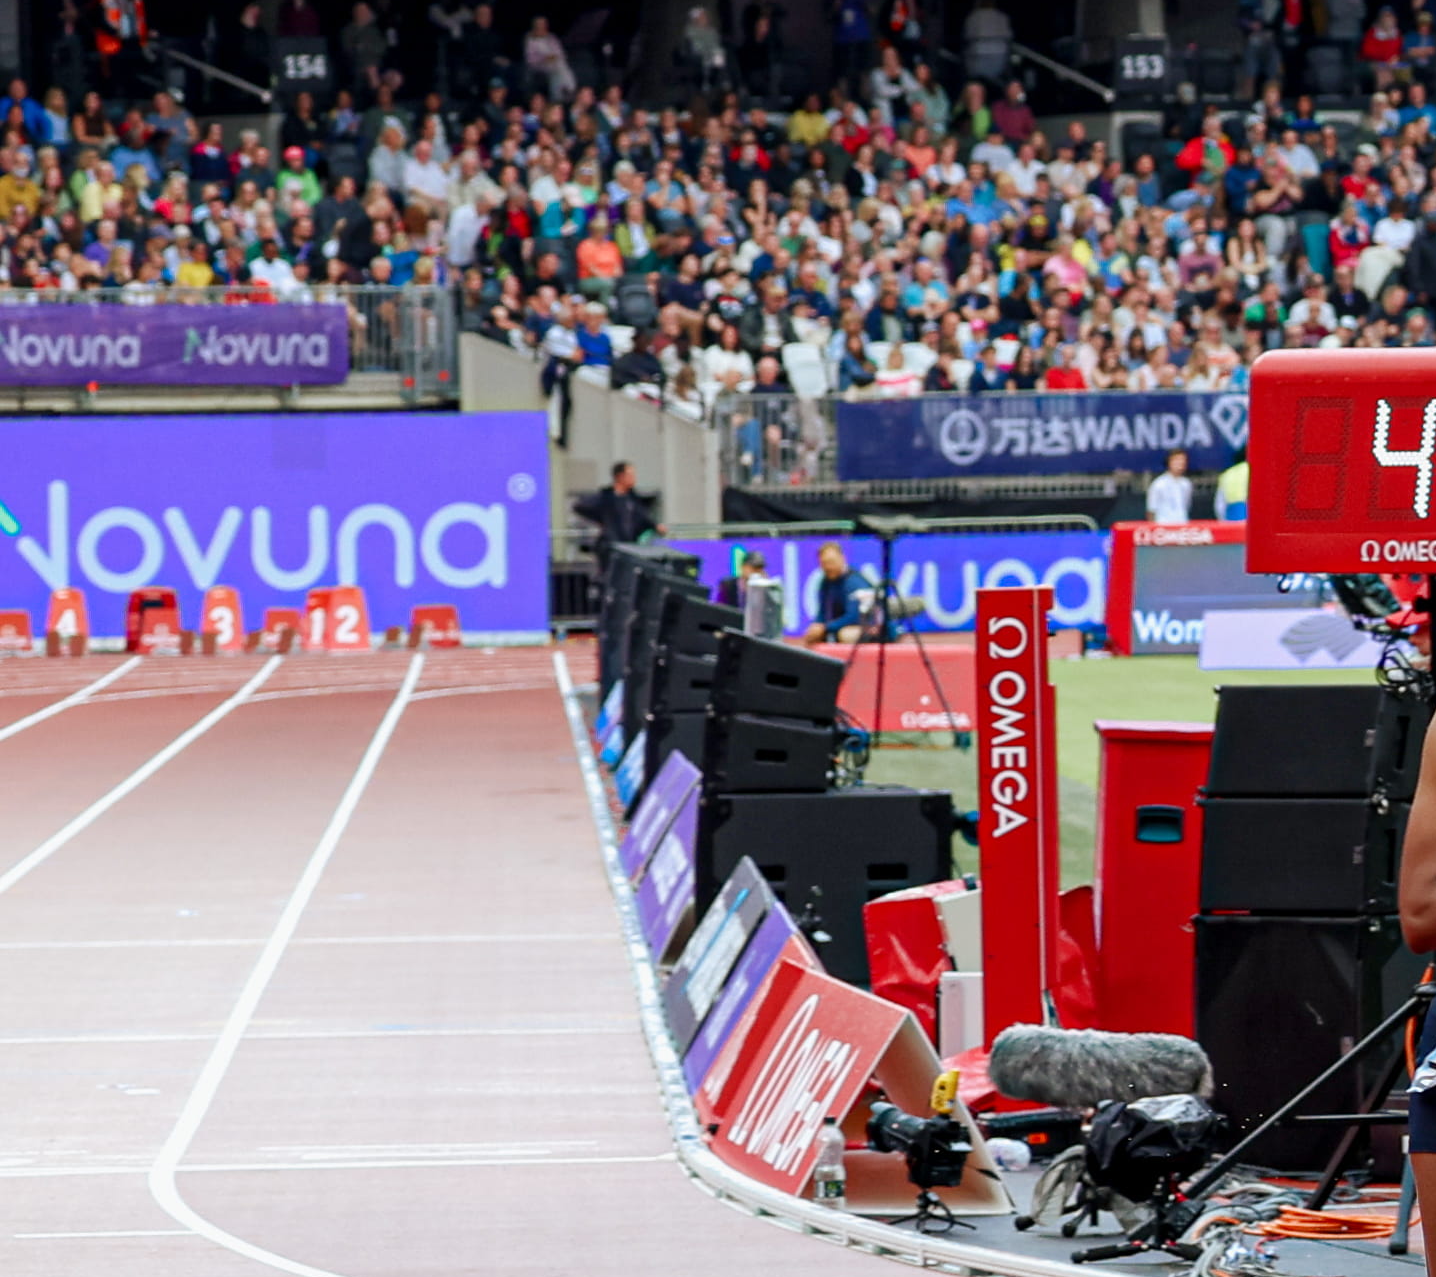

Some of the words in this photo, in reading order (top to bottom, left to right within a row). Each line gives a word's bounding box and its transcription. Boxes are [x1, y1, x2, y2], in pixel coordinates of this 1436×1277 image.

[283, 53, 328, 81] 154
[1120, 53, 1166, 80] 153
[184, 327, 329, 369] Novuna
[55, 609, 78, 637] 4
[208, 605, 235, 644] 3
[309, 608, 325, 644] 1
[333, 605, 362, 644] 2
[988, 670, 1031, 839] OMEGA
